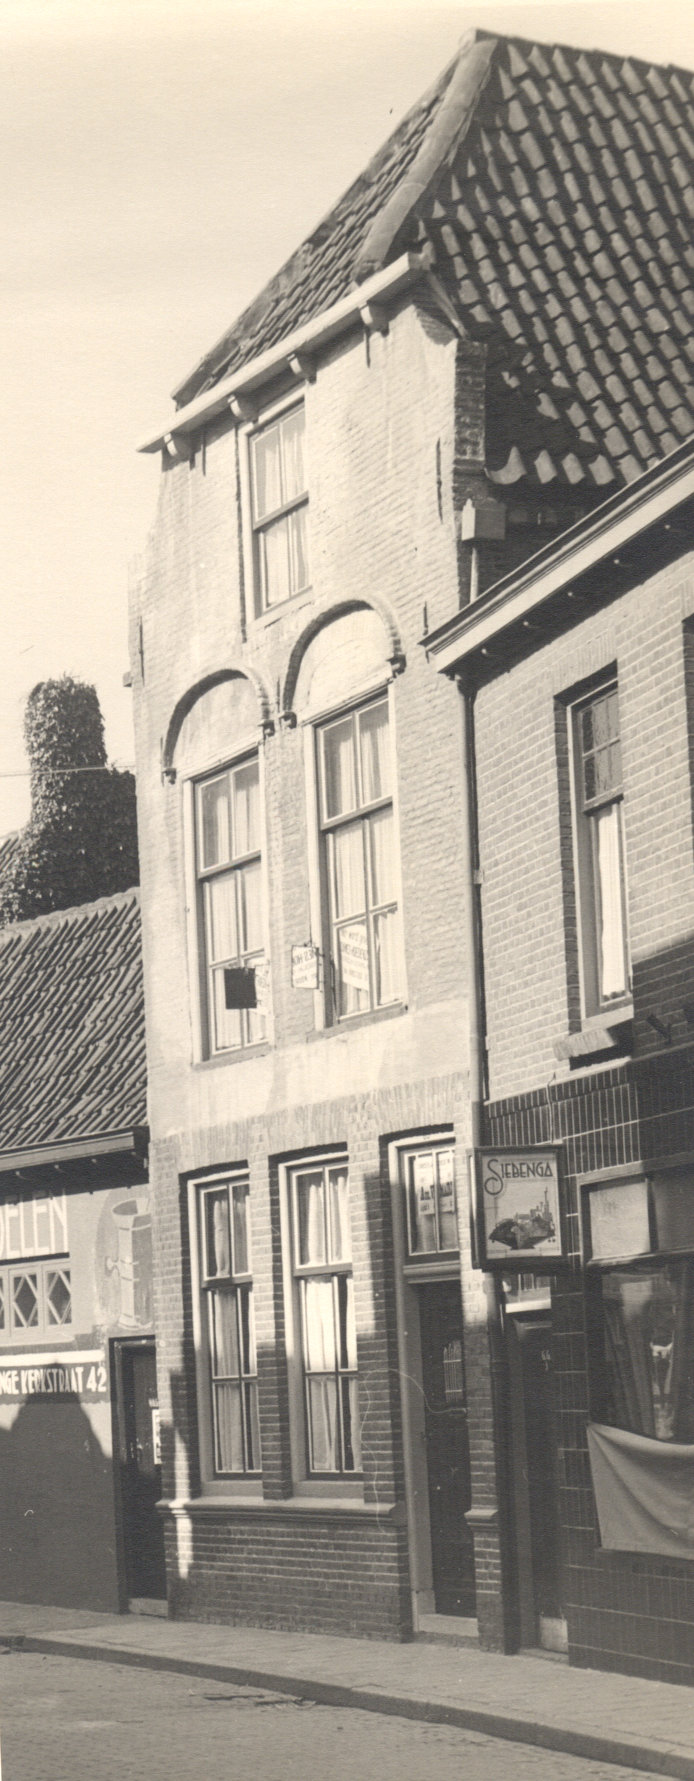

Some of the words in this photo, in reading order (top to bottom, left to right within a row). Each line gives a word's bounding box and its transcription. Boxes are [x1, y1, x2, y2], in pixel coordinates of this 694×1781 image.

[484, 1158, 554, 1196] SIEBENGA
[20, 1367, 84, 1394] KERKSTRAAT
[86, 1365, 108, 1393] 42
